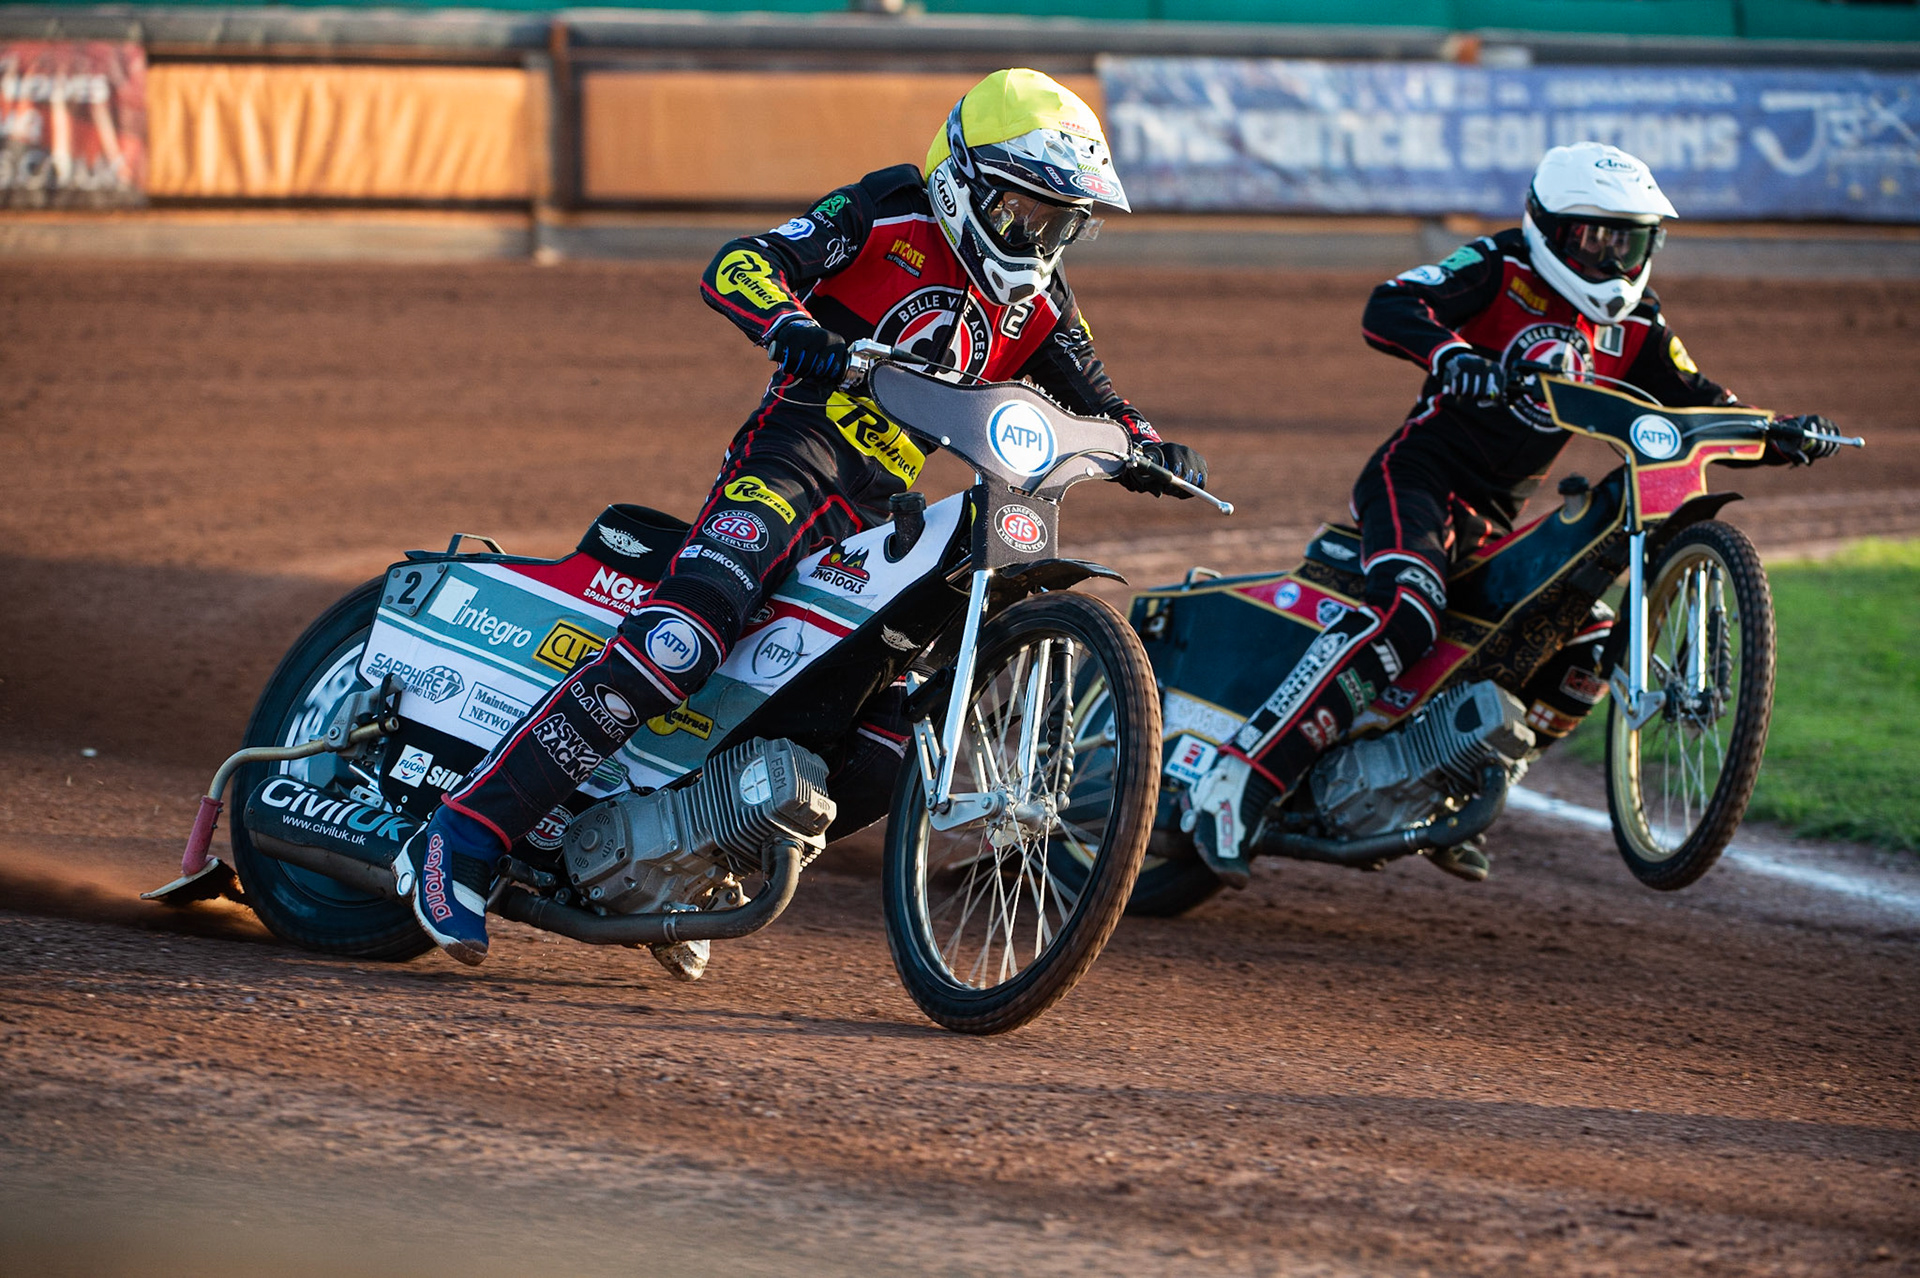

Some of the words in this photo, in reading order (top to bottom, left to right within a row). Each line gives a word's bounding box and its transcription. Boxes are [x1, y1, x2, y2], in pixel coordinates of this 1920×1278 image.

[1460, 112, 1741, 172] SOLUTIONS
[935, 178, 956, 212] Arai
[898, 294, 940, 323] BELLE
[970, 321, 984, 362] ACES
[1005, 303, 1029, 334] 2
[1518, 326, 1558, 350] BELLE
[836, 396, 917, 482] Rentruck
[1001, 424, 1042, 452] ATPI
[1639, 429, 1672, 446] ATPI
[731, 480, 793, 520] Rentruck
[717, 518, 752, 538] STS
[1008, 516, 1033, 539] STS
[397, 571, 422, 605] 2
[583, 587, 612, 605] SPARK
[589, 566, 653, 606] NGK
[830, 571, 867, 595] TOOLS
[452, 599, 533, 648] integro
[656, 630, 690, 660] ATPI
[760, 642, 795, 666] ATPI
[370, 652, 444, 694] SAPPHIRE
[468, 704, 514, 732] NETWO
[398, 758, 427, 774] FUCHS
[281, 814, 367, 846] www.civiluk.uk
[535, 817, 566, 837] STS
[424, 833, 453, 923] daytona
